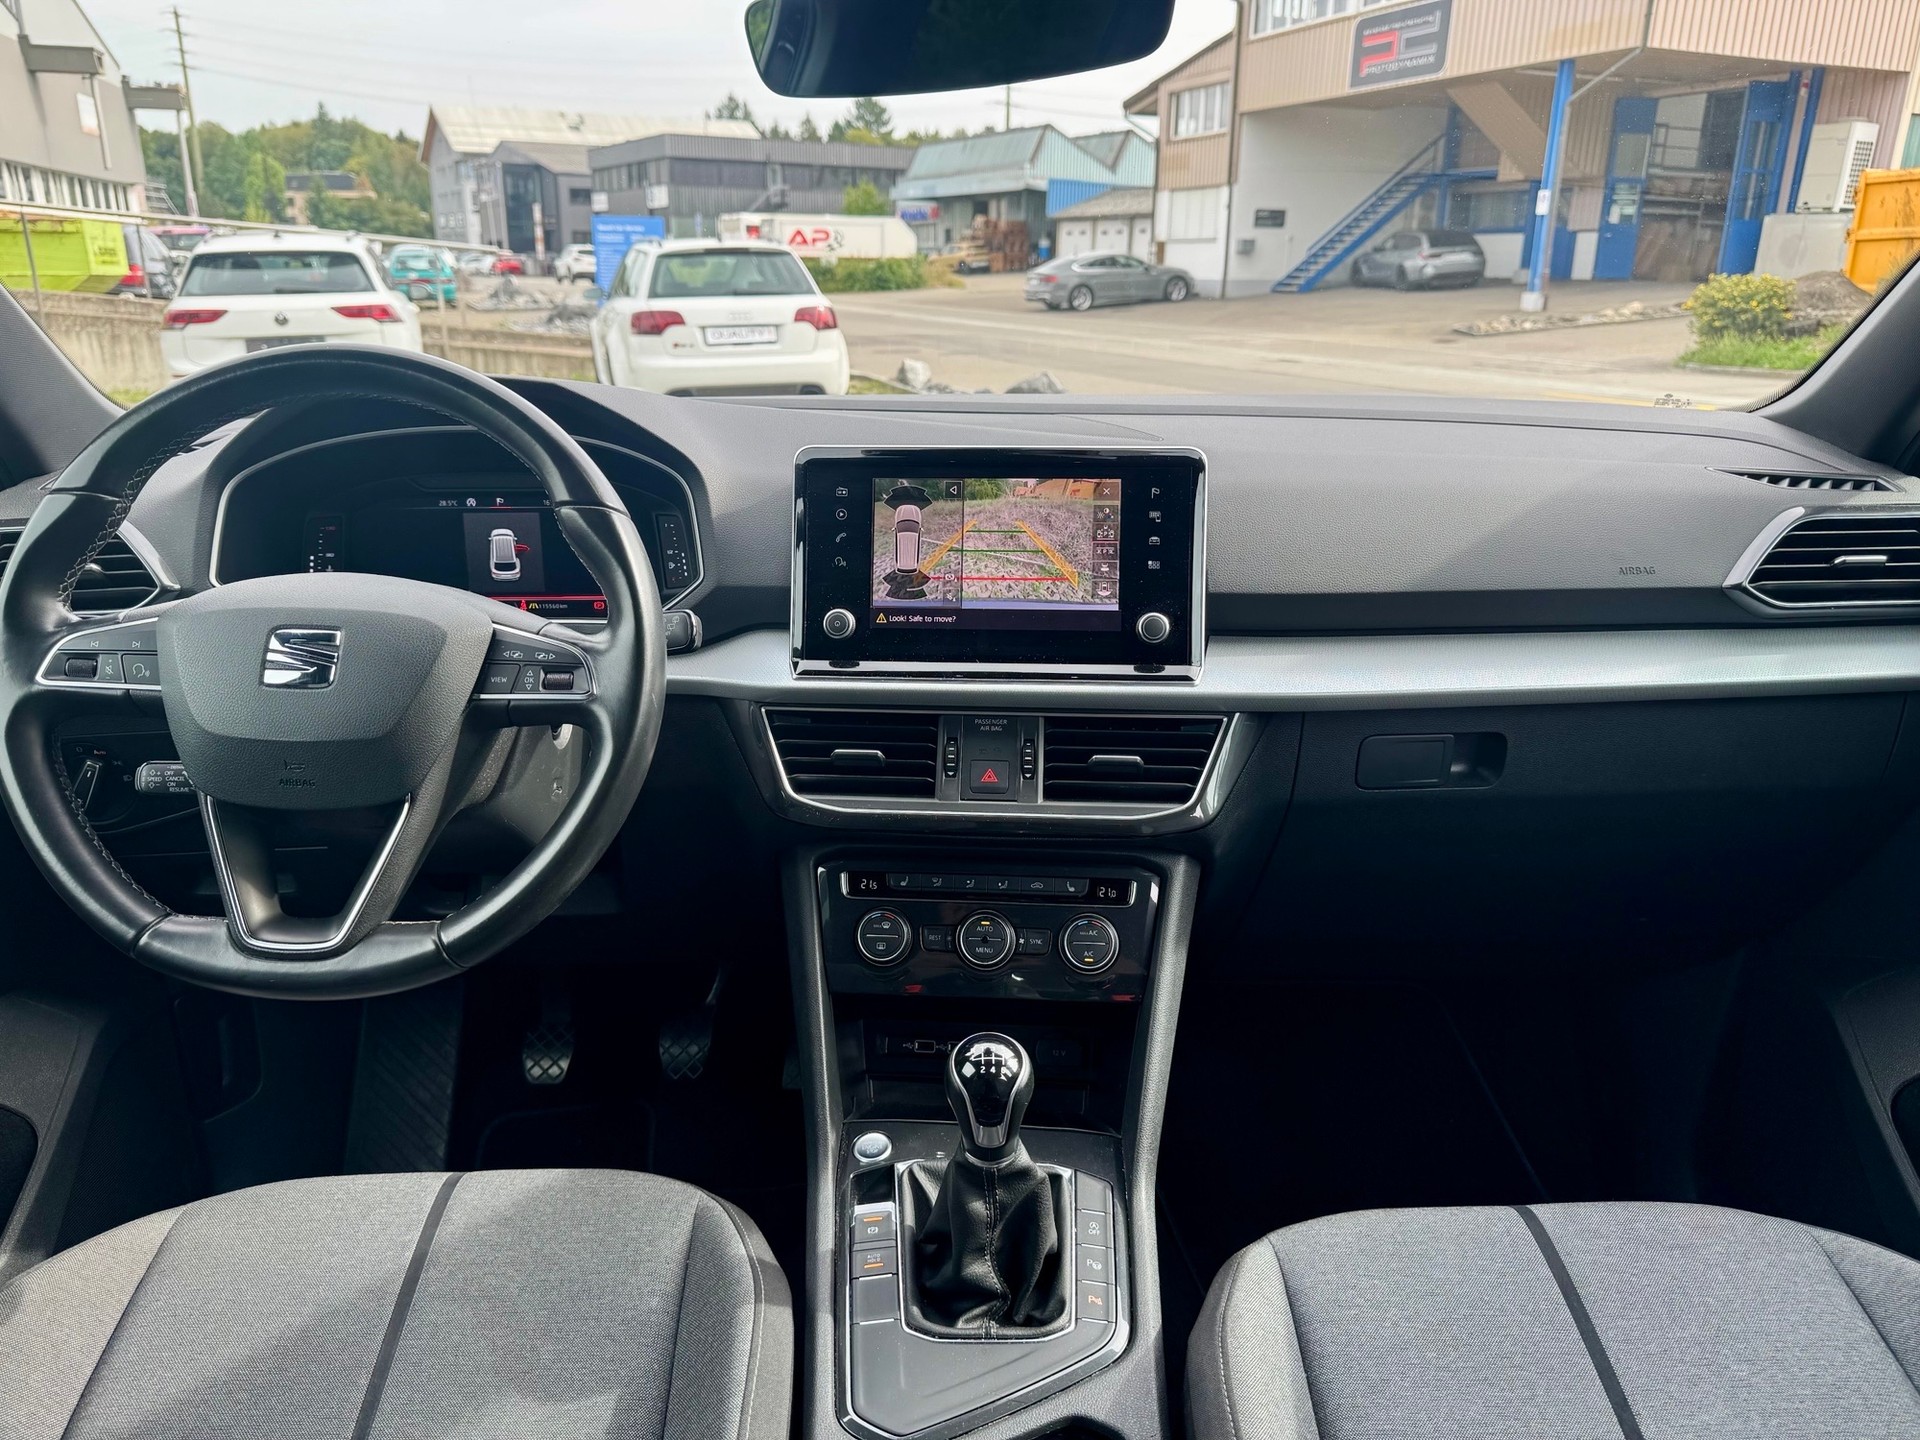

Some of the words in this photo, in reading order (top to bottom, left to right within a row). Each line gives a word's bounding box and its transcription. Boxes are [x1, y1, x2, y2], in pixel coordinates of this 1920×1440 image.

[1618, 566, 1656, 576] AIRBAG
[908, 615, 923, 623] Safe
[924, 615, 933, 623] to
[933, 615, 957, 623] move?
[524, 676, 534, 684] OK
[279, 778, 316, 788] AIRBAG
[980, 1065, 986, 1074] 2
[990, 1065, 996, 1074] 4
[1088, 1228, 1100, 1237] OFF
